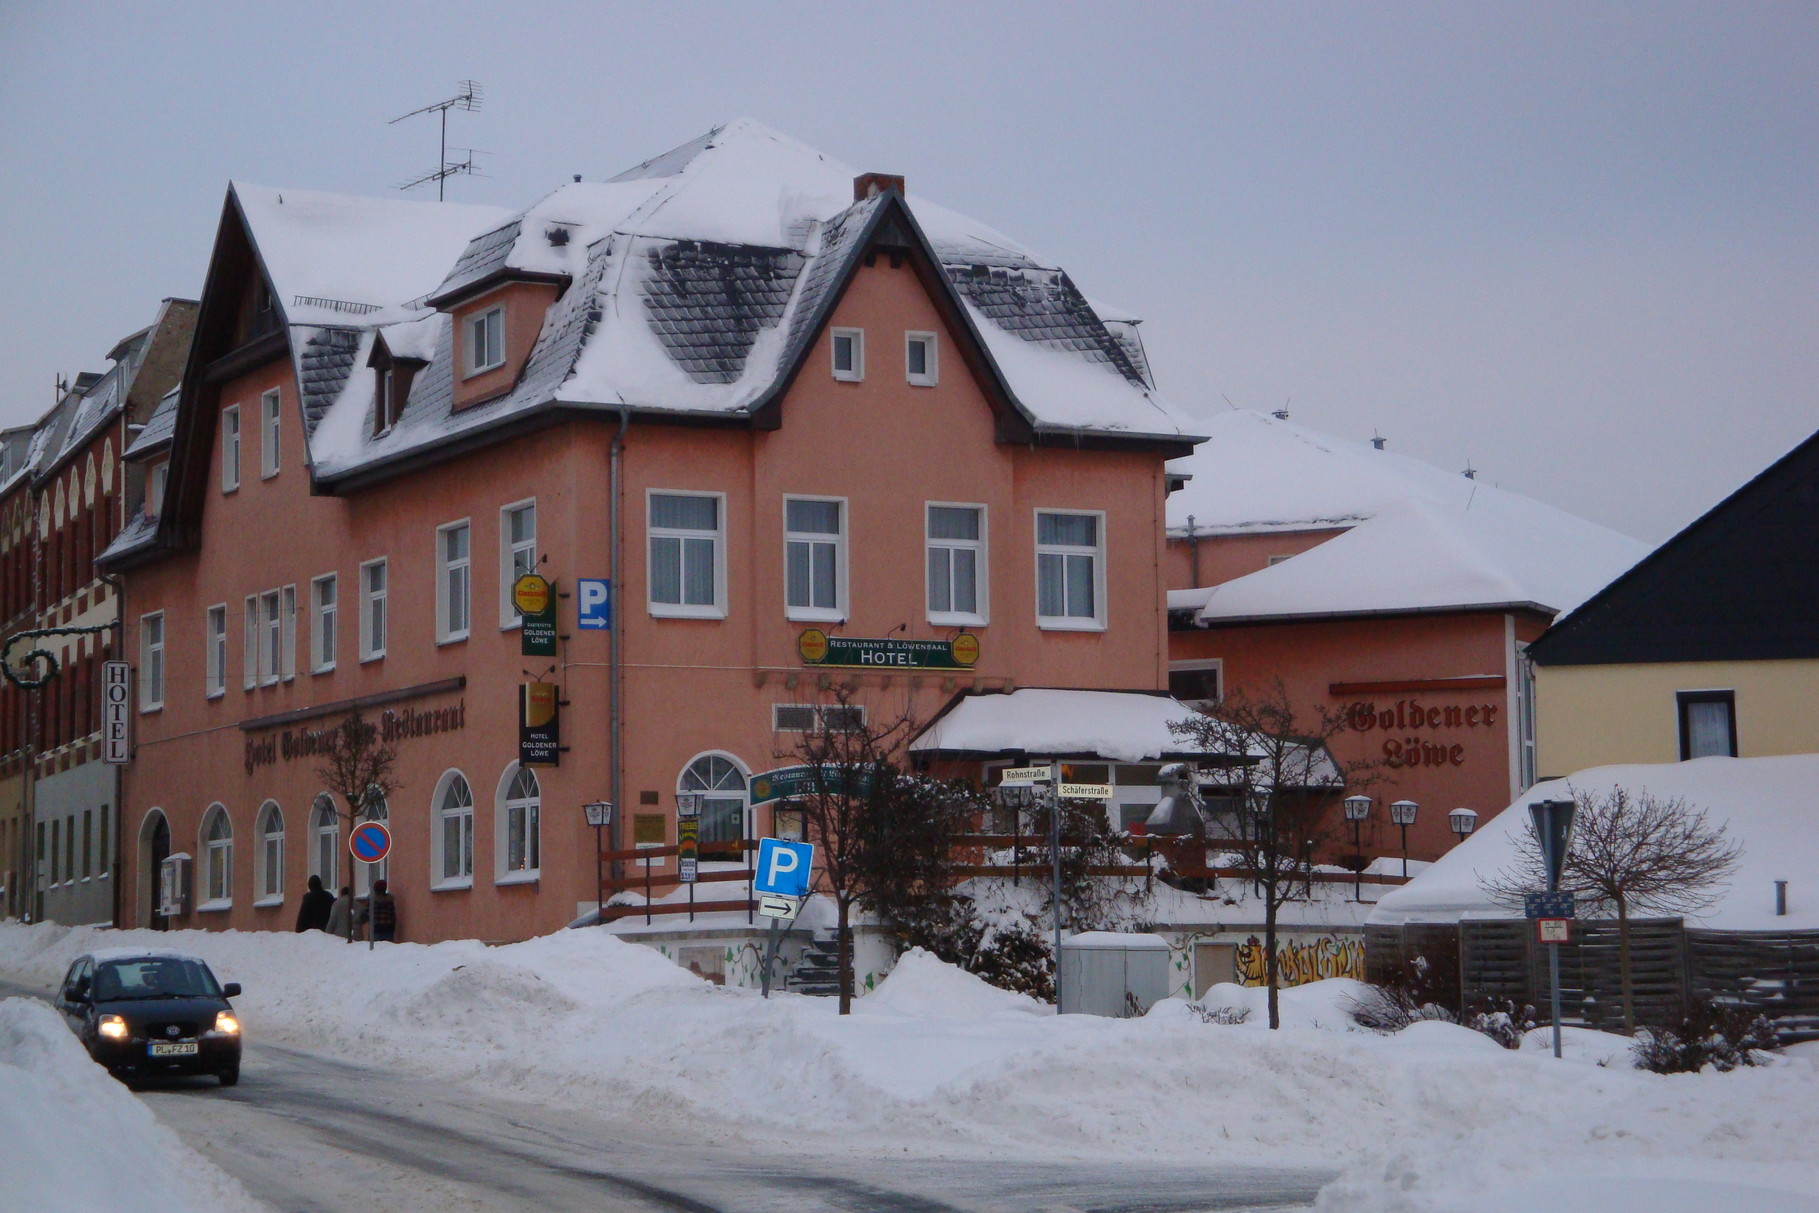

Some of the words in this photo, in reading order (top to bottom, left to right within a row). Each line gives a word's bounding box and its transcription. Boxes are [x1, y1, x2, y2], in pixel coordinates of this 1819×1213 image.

[580, 581, 608, 615] P
[523, 628, 556, 637] GOLDENER
[531, 636, 549, 644] LÖWE
[830, 640, 885, 649] RESTAURANT
[896, 642, 948, 651] LÖWENSAAL
[860, 650, 918, 665] HOTEL
[108, 666, 127, 759] HOTEL
[1347, 699, 1499, 733] Goldener
[244, 732, 278, 777] Hotel
[381, 697, 466, 743] Restaurant
[522, 741, 557, 749] GOLDENER
[530, 749, 549, 757] LÖWE
[1382, 736, 1465, 768] Löwe
[1006, 769, 1046, 779] Rohnstraße
[1062, 785, 1109, 796] Schäferstraße
[767, 846, 799, 887] P
